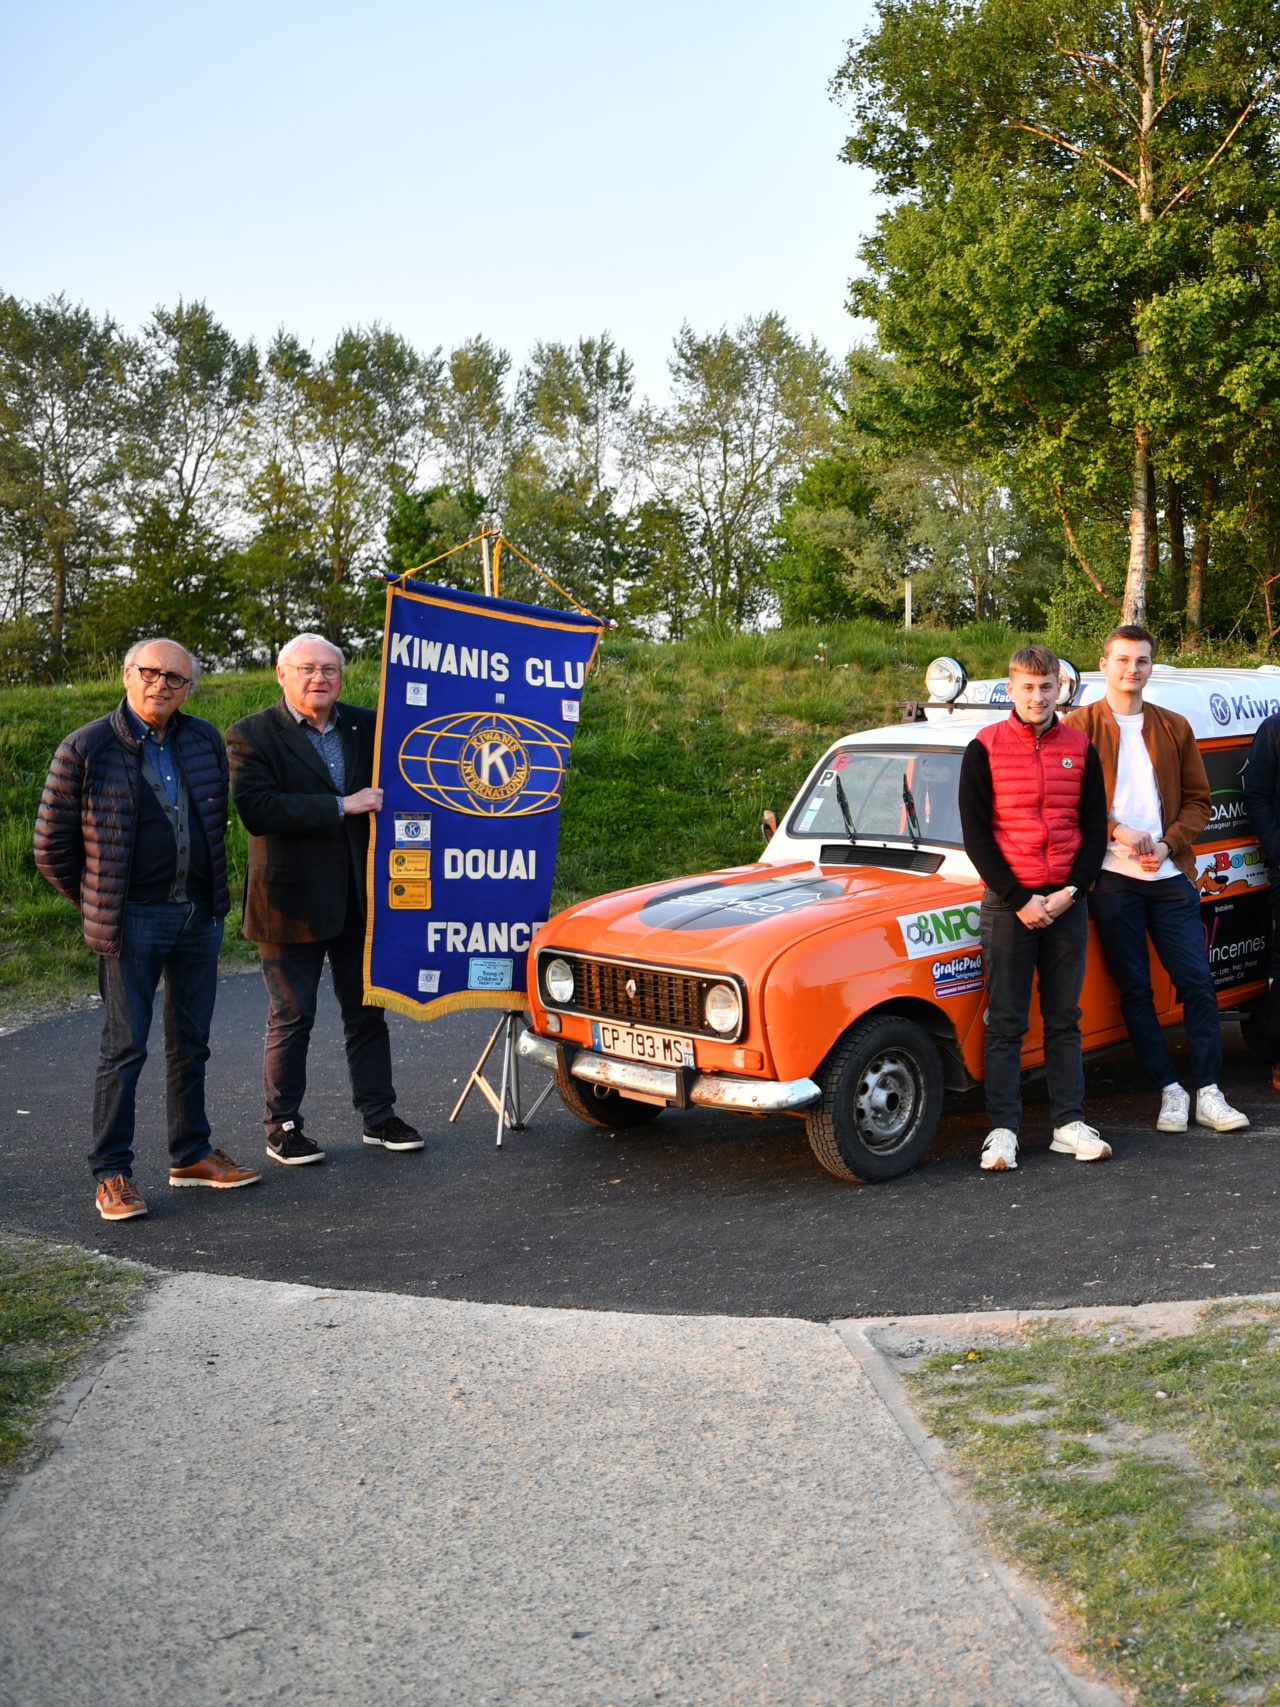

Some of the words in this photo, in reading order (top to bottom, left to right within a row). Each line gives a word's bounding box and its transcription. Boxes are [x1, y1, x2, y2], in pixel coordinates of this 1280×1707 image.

[390, 632, 510, 682] KIWANIS
[525, 657, 588, 689] CLU
[470, 731, 520, 752] KIWANIS
[463, 760, 526, 798] INTERNATIONAL
[479, 742, 511, 786] K
[820, 771, 834, 785] P
[444, 848, 536, 880] DOUAI
